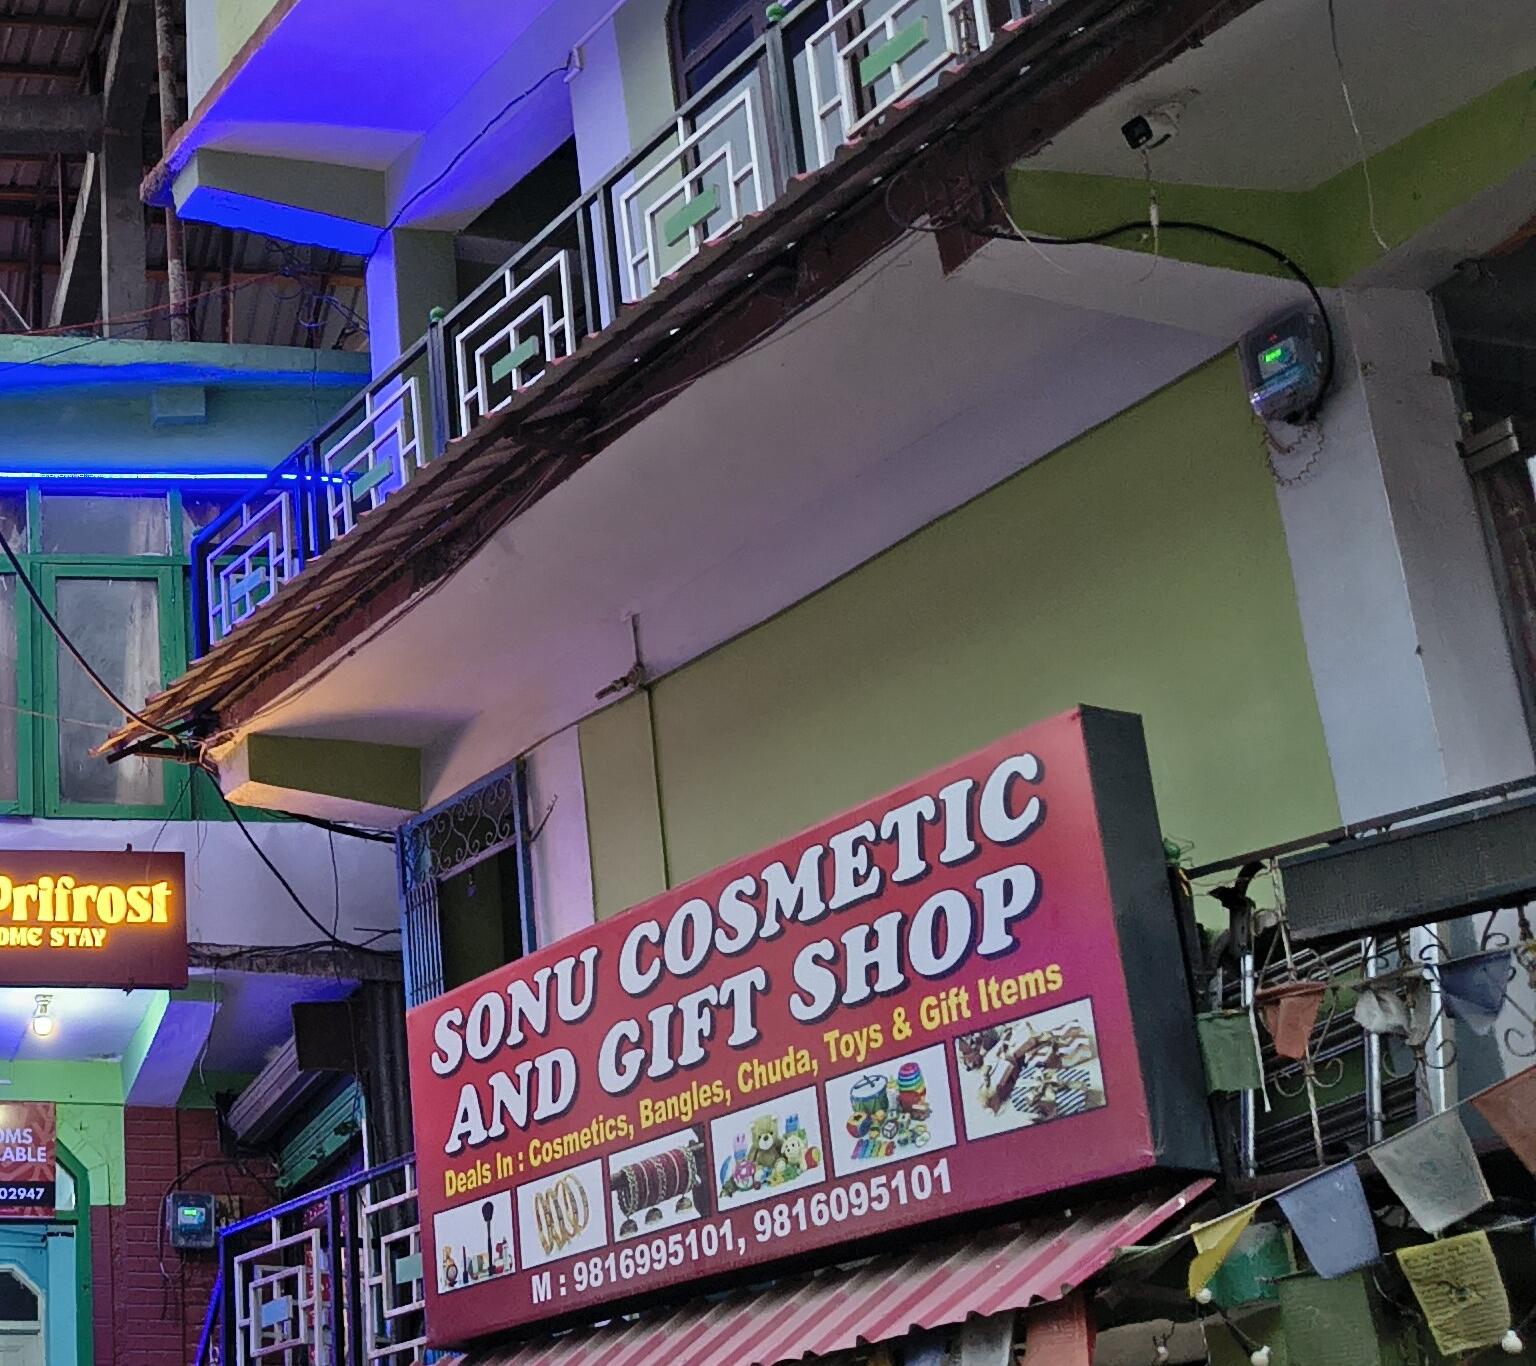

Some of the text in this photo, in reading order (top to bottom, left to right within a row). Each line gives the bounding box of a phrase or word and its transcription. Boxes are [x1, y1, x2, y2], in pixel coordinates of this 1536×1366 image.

[50, 927, 107, 948] STAY
[430, 752, 1042, 1075] SONU COSMETIC
[444, 864, 1039, 1155] AND GIFT SHOP
[444, 1160, 492, 1197] Deals
[528, 1115, 635, 1168] Cosmetics,
[639, 1079, 732, 1130] Bangles,
[737, 1047, 819, 1094] Chuda,
[824, 1023, 884, 1064] Toys
[892, 1007, 912, 1042] &
[920, 989, 971, 1032] Gift
[979, 963, 1063, 1012] Items
[754, 1158, 952, 1242] 9816095101
